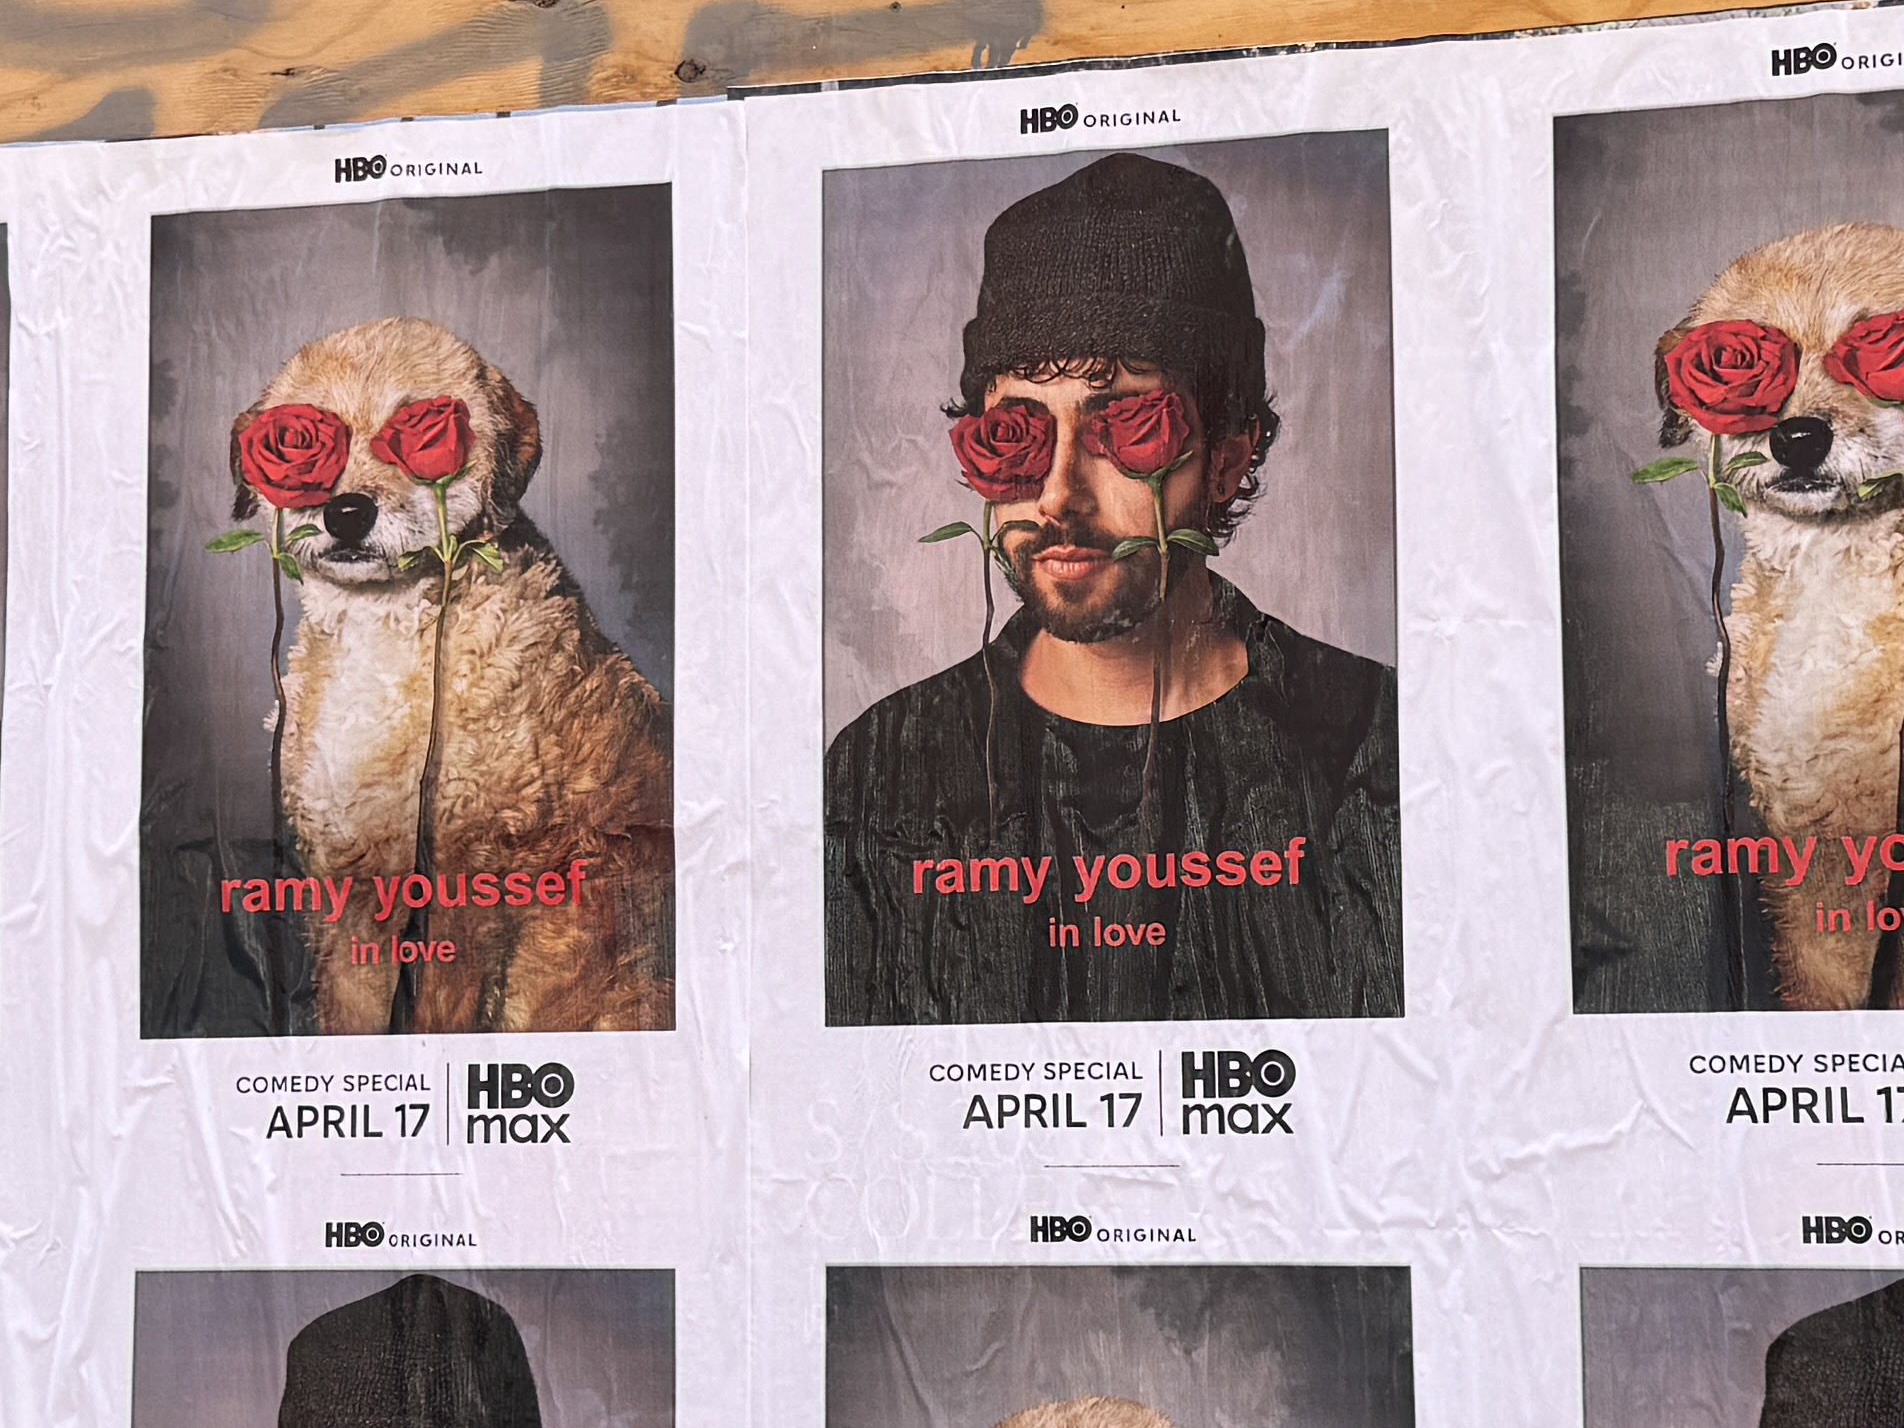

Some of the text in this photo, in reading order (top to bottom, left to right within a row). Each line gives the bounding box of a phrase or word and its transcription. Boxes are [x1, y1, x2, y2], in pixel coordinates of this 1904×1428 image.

[1772, 43, 1837, 76] HBO
[1021, 104, 1180, 134] HBO ORIGINAL
[335, 155, 482, 183] HBO ORIGINAL
[912, 836, 1305, 903] ramy youssef
[1665, 835, 1816, 887] ramy
[221, 858, 591, 923] ramy youssef
[1049, 917, 1165, 947] in love
[1817, 903, 1851, 933] in
[352, 935, 456, 965] in love
[930, 1062, 1143, 1081] COMEDY SPECIAL
[1182, 1049, 1296, 1098] HBO
[1690, 1054, 1803, 1073] COMEDY
[237, 1074, 430, 1093] COMEDY SPECIAL
[468, 1063, 574, 1109] HBO
[963, 1093, 1142, 1129] APRIL 17
[1183, 1103, 1293, 1134] max
[1727, 1087, 1864, 1123] APRIL
[267, 1104, 429, 1139] APRIL 17
[467, 1114, 570, 1143] max
[326, 1222, 476, 1247] HBO ORIGINAL
[1031, 1216, 1196, 1242] HBO ORIGINAL
[1802, 1216, 1872, 1244] HBO
